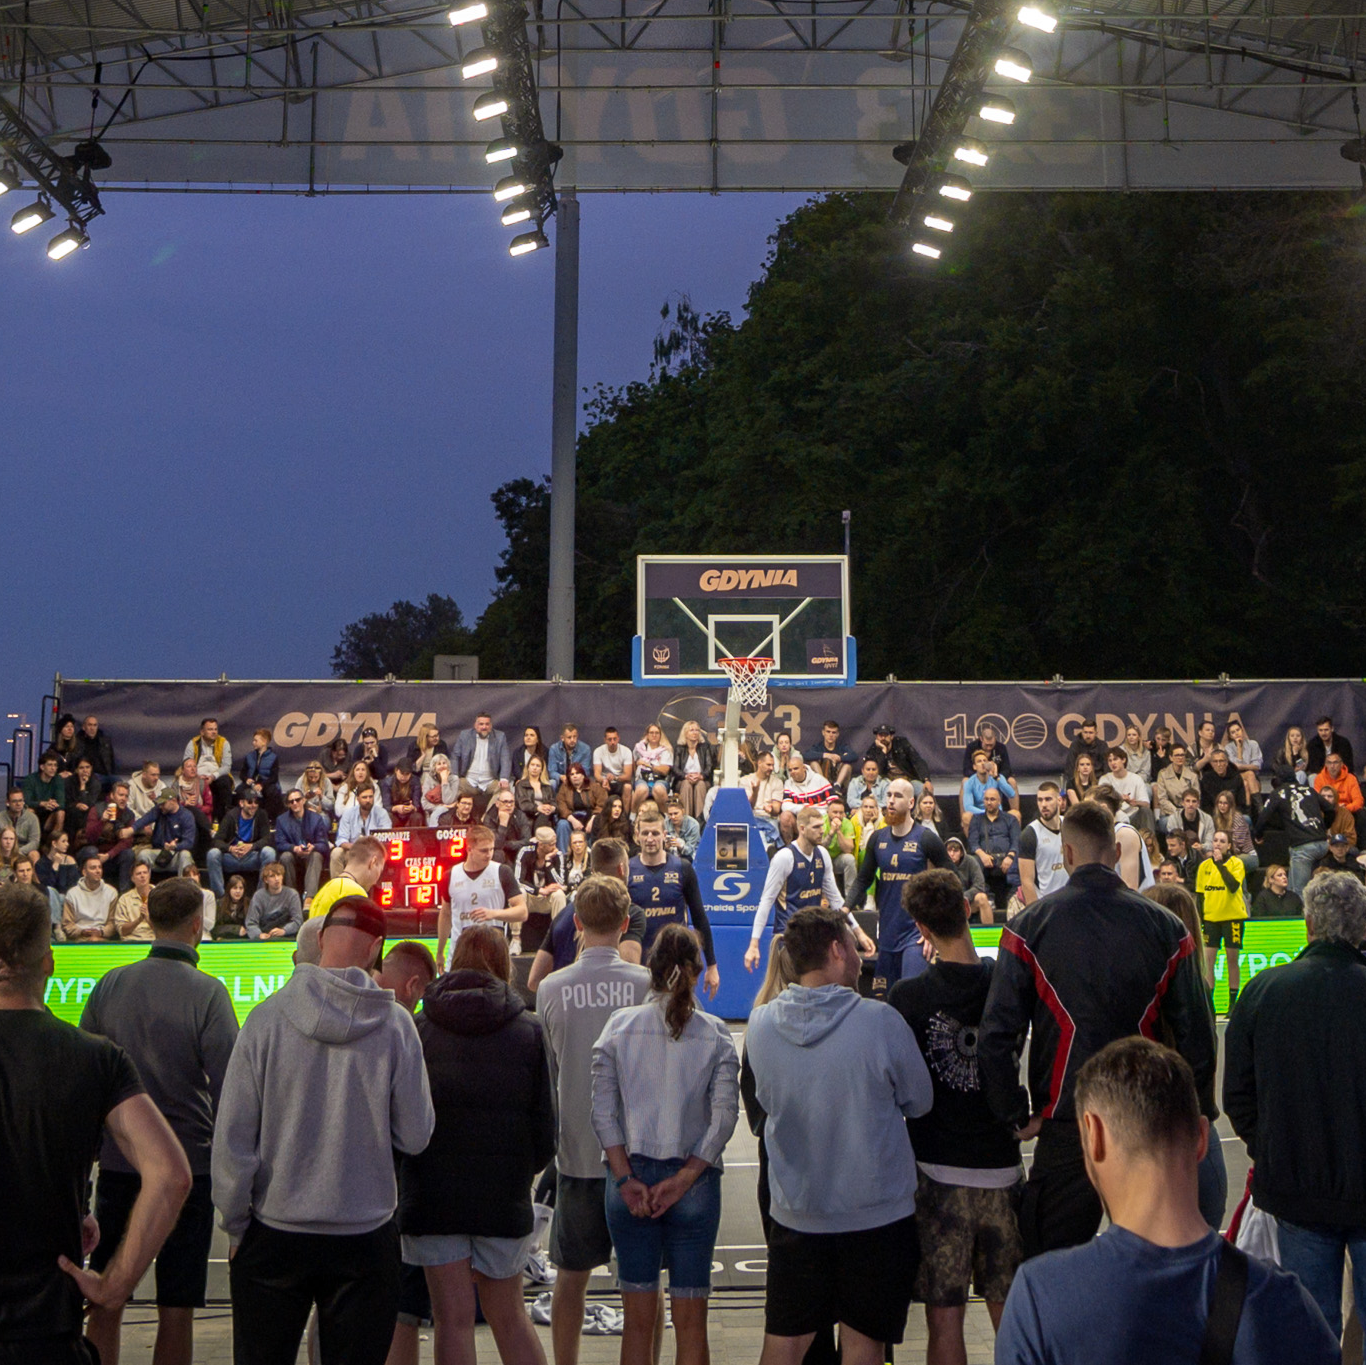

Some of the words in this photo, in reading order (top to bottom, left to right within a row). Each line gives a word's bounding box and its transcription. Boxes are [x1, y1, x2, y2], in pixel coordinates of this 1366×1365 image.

[699, 569, 798, 592] GDYNIA
[273, 712, 437, 747] GDYNIA
[1056, 712, 1248, 749] GDYNA
[436, 828, 467, 840] GOŚCIE
[390, 839, 403, 860] 3
[450, 837, 464, 857] 2
[890, 853, 898, 867] 4
[810, 871, 815, 884] 3
[381, 888, 393, 905] 2
[417, 887, 432, 903] 12
[471, 892, 479, 905] 2
[651, 886, 660, 901] 2
[644, 906, 676, 918] DYNIA
[736, 904, 760, 914] Spor
[561, 982, 635, 1011] POLSKA
